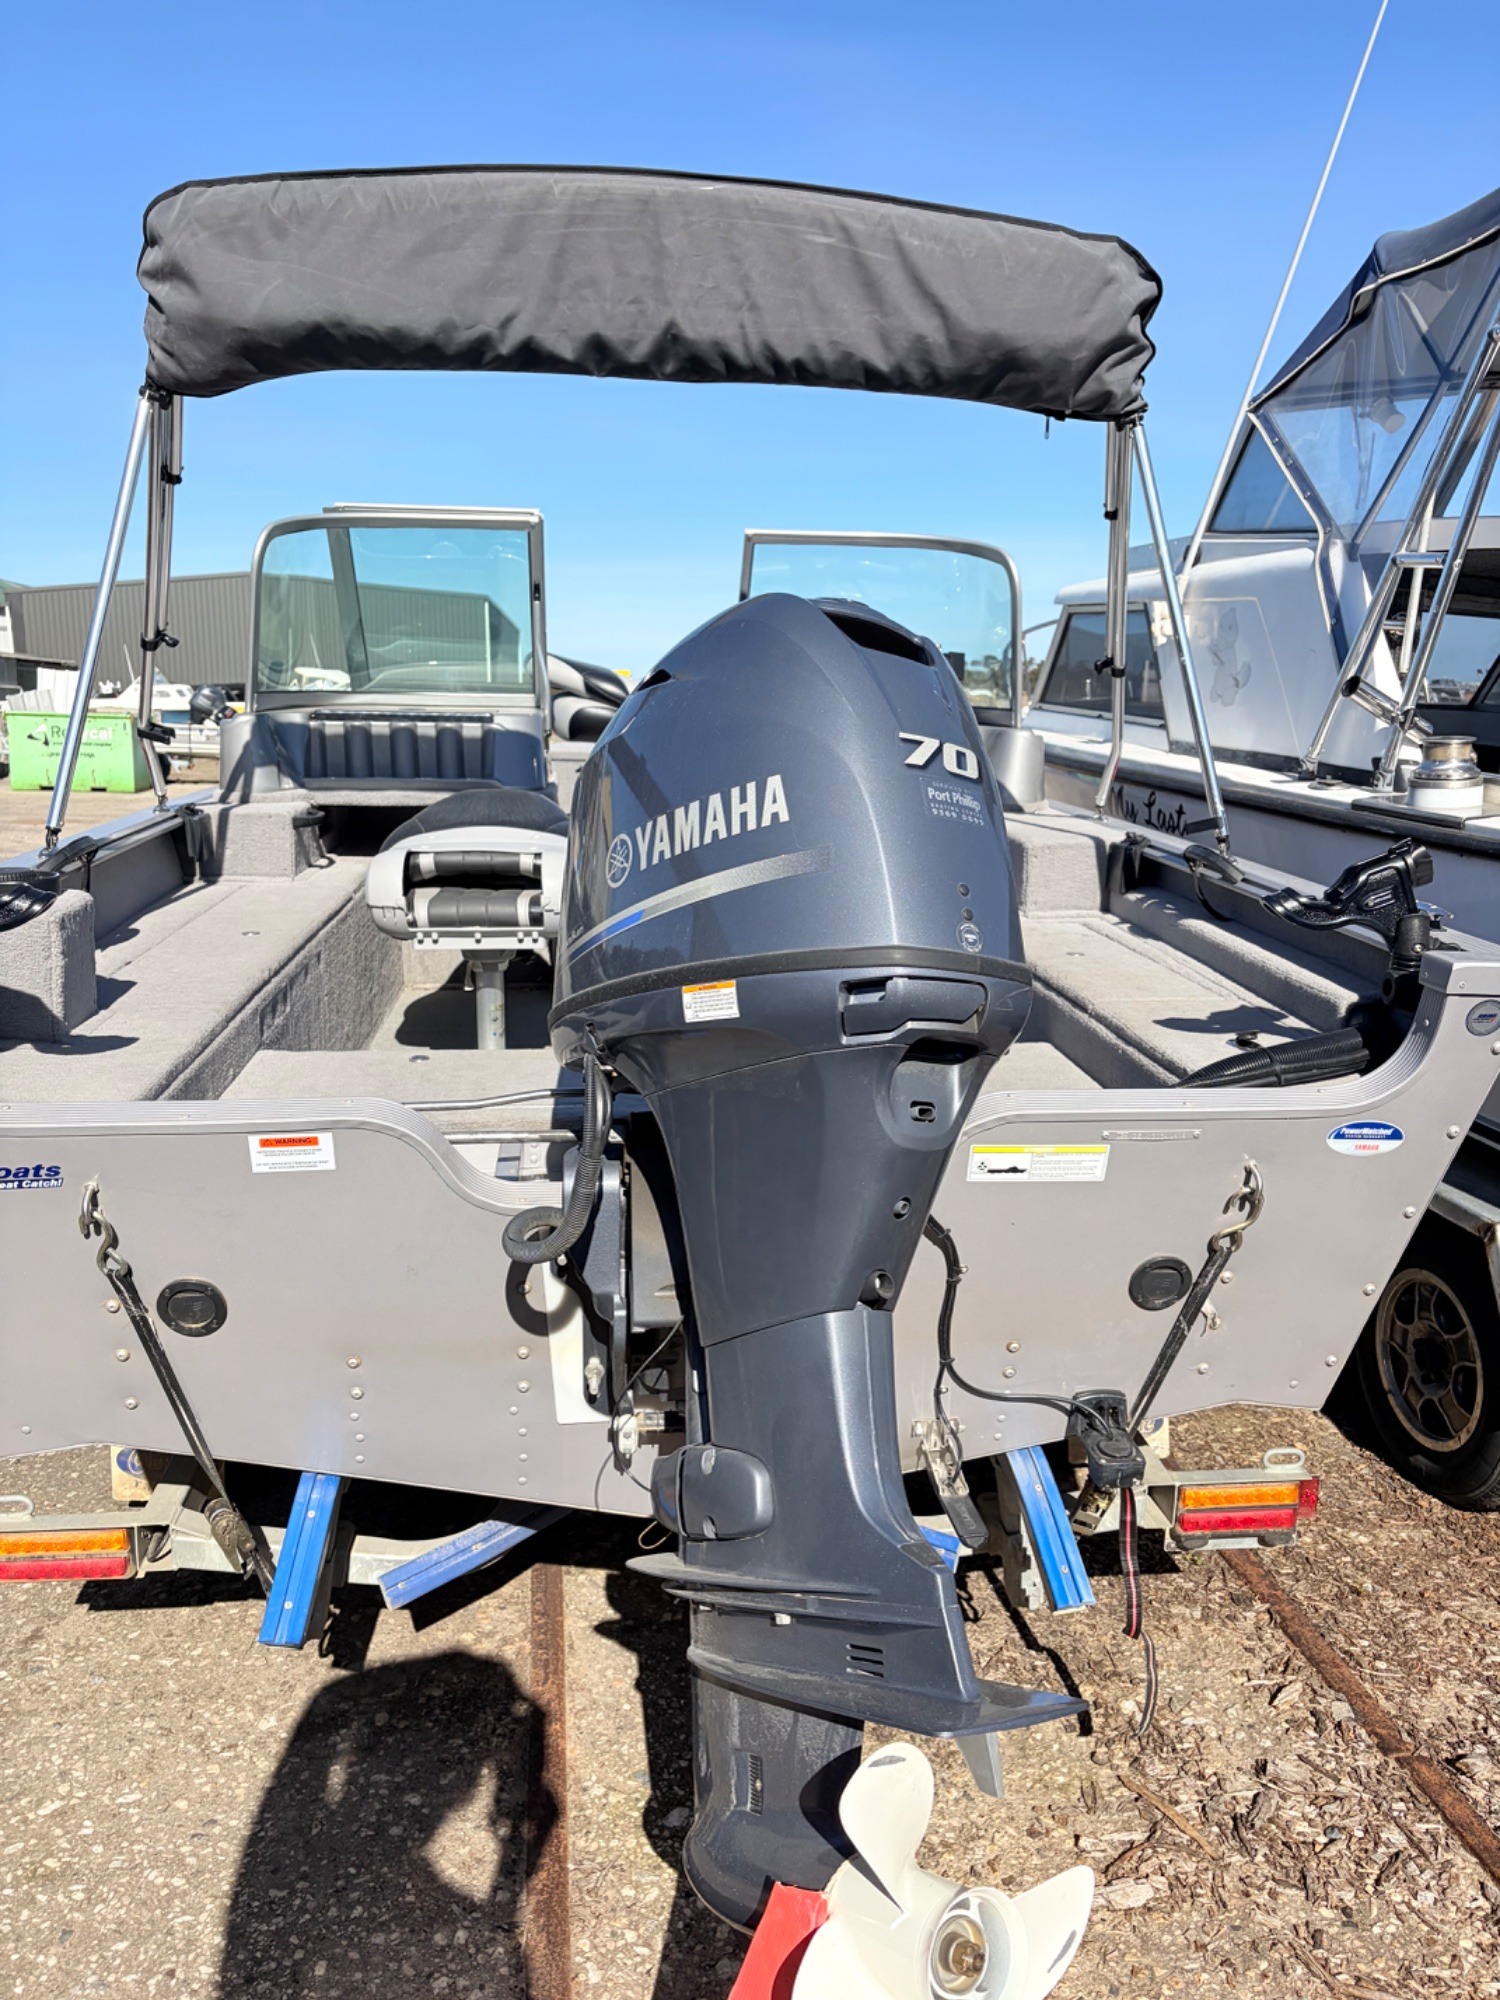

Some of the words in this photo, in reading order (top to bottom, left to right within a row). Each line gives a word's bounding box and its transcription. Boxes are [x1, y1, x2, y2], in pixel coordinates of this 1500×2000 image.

[899, 732, 979, 780] 70
[927, 787, 951, 803] Port
[952, 792, 981, 812] Phillip
[1143, 790, 1188, 837] Last
[635, 774, 790, 871] YAMAHA
[274, 1137, 312, 1145] WARNING
[22, 1179, 62, 1188] Catch!
